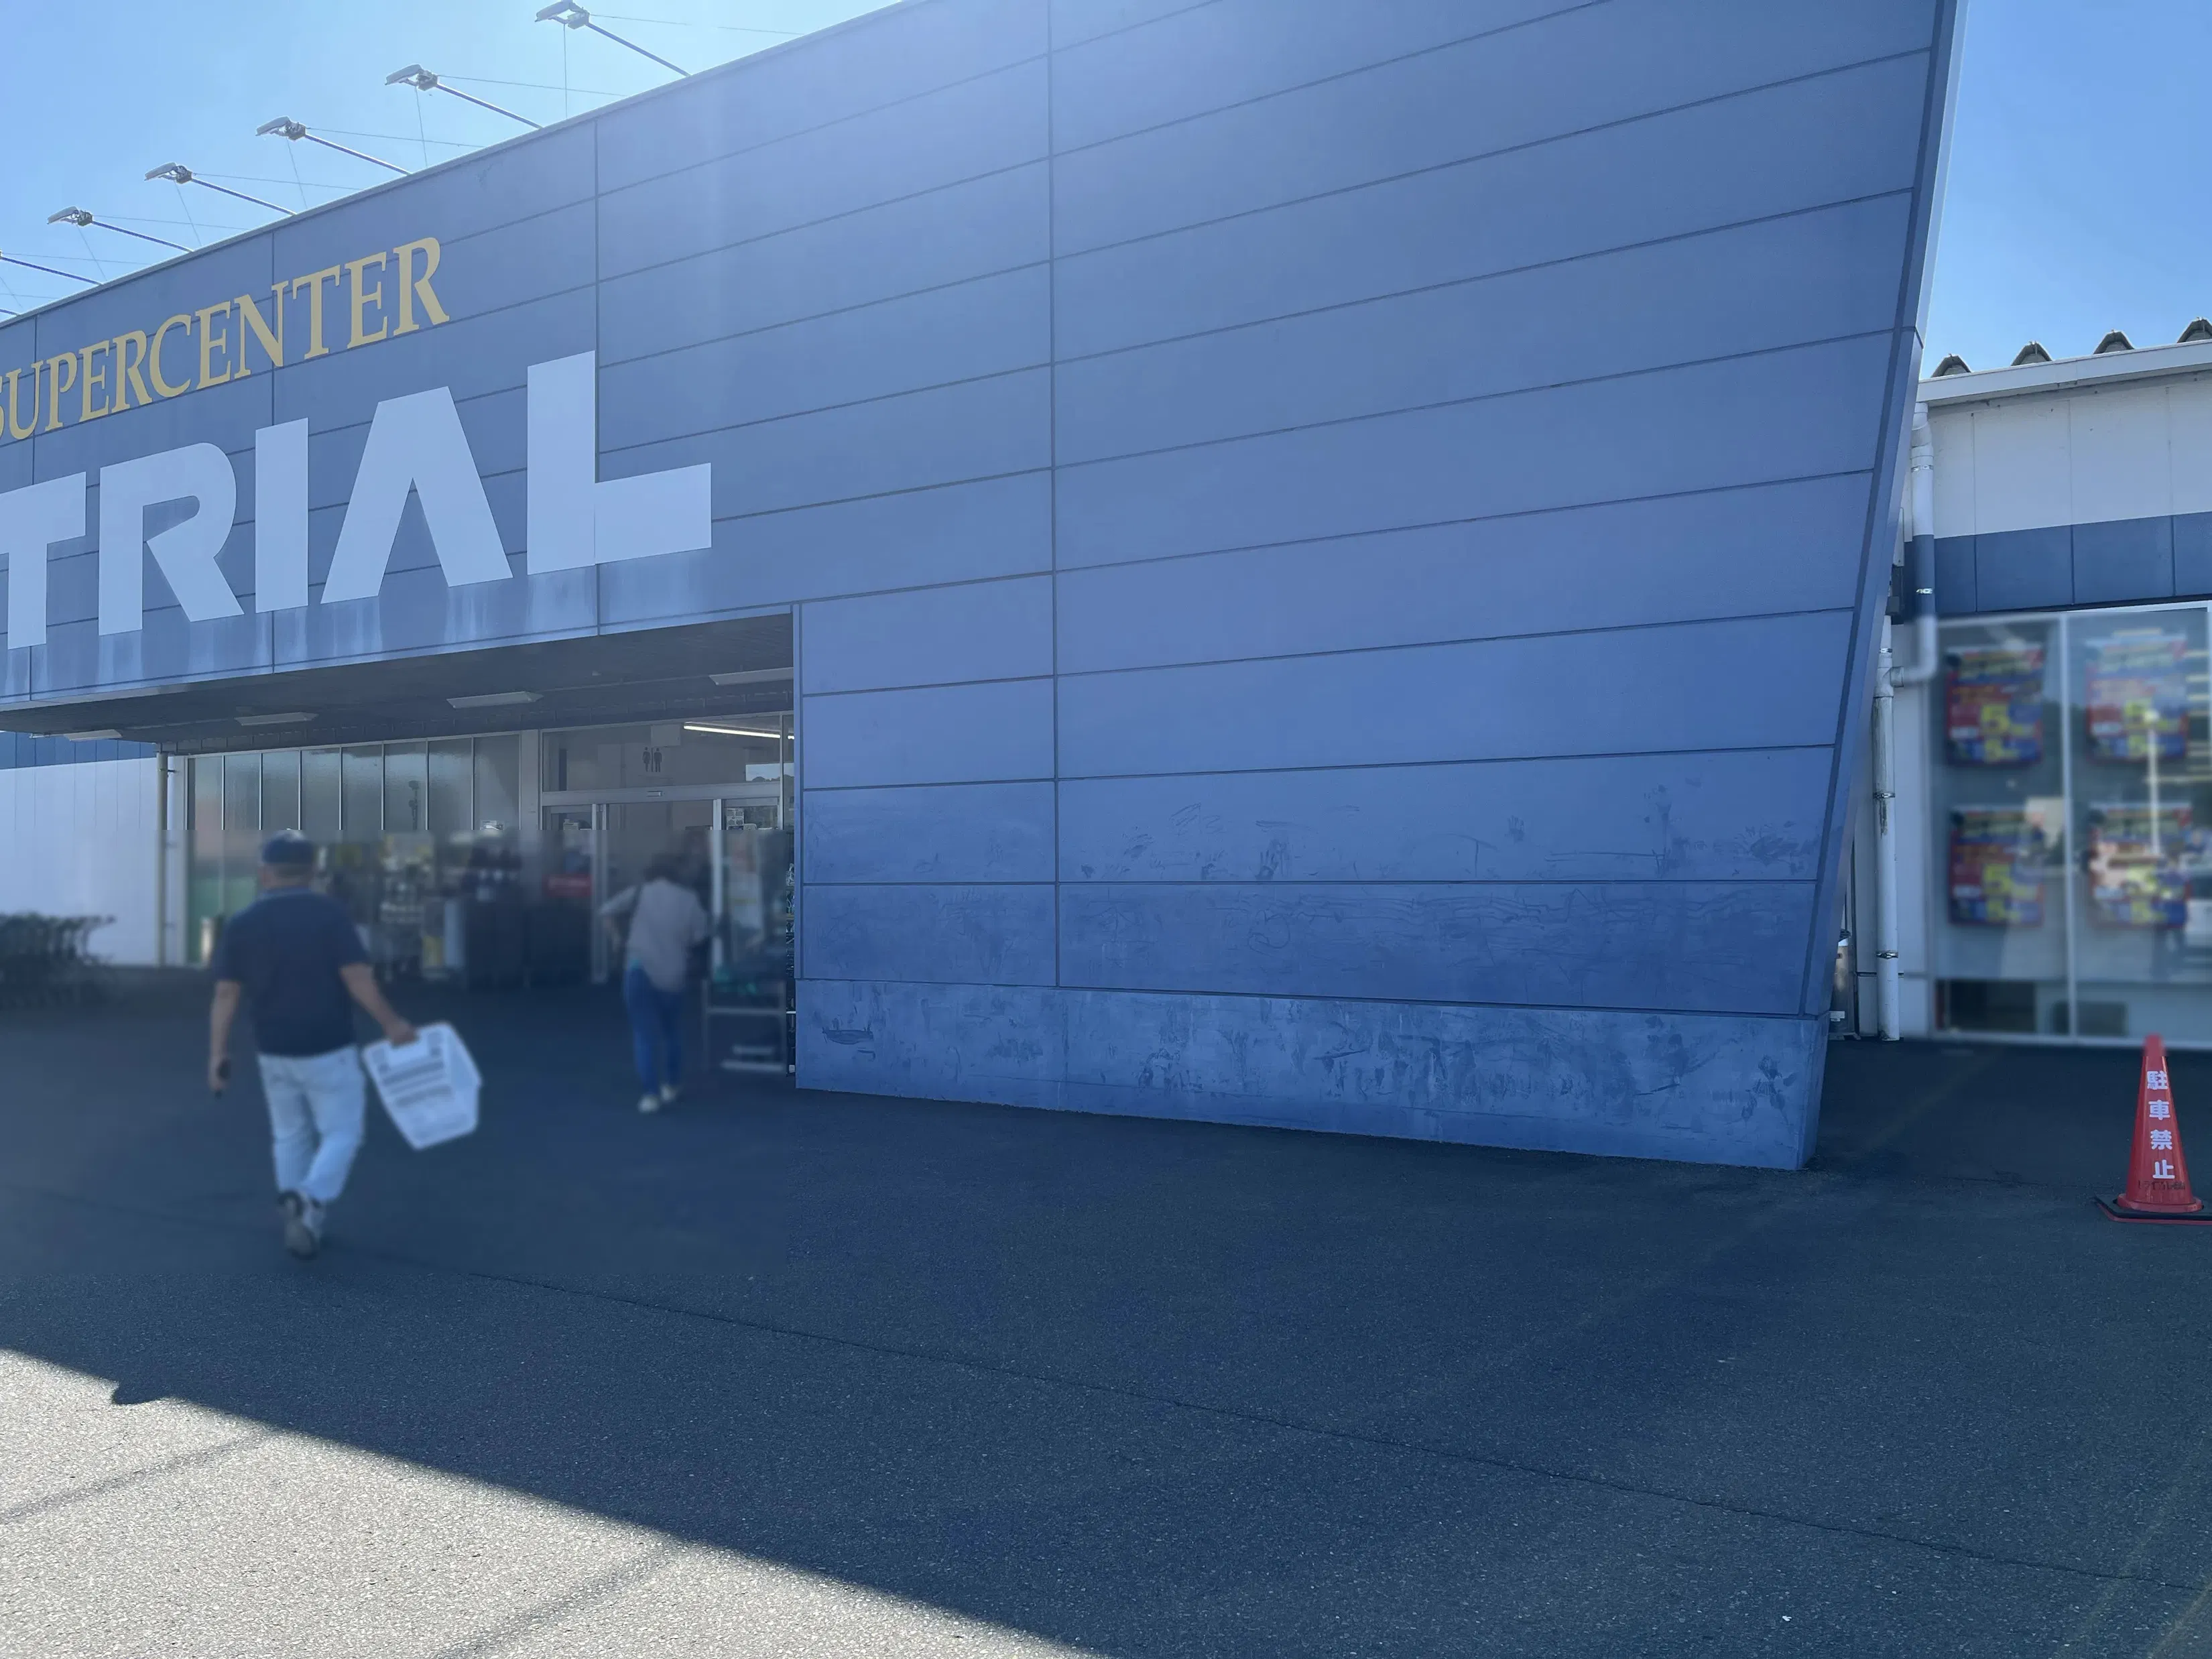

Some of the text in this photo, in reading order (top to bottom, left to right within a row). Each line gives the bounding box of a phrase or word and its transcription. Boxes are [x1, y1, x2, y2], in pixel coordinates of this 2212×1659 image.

[0, 237, 450, 440] UPERCENTER
[0, 350, 712, 650] TRIAL
[2146, 1070, 2175, 1179] 駐車禁止
